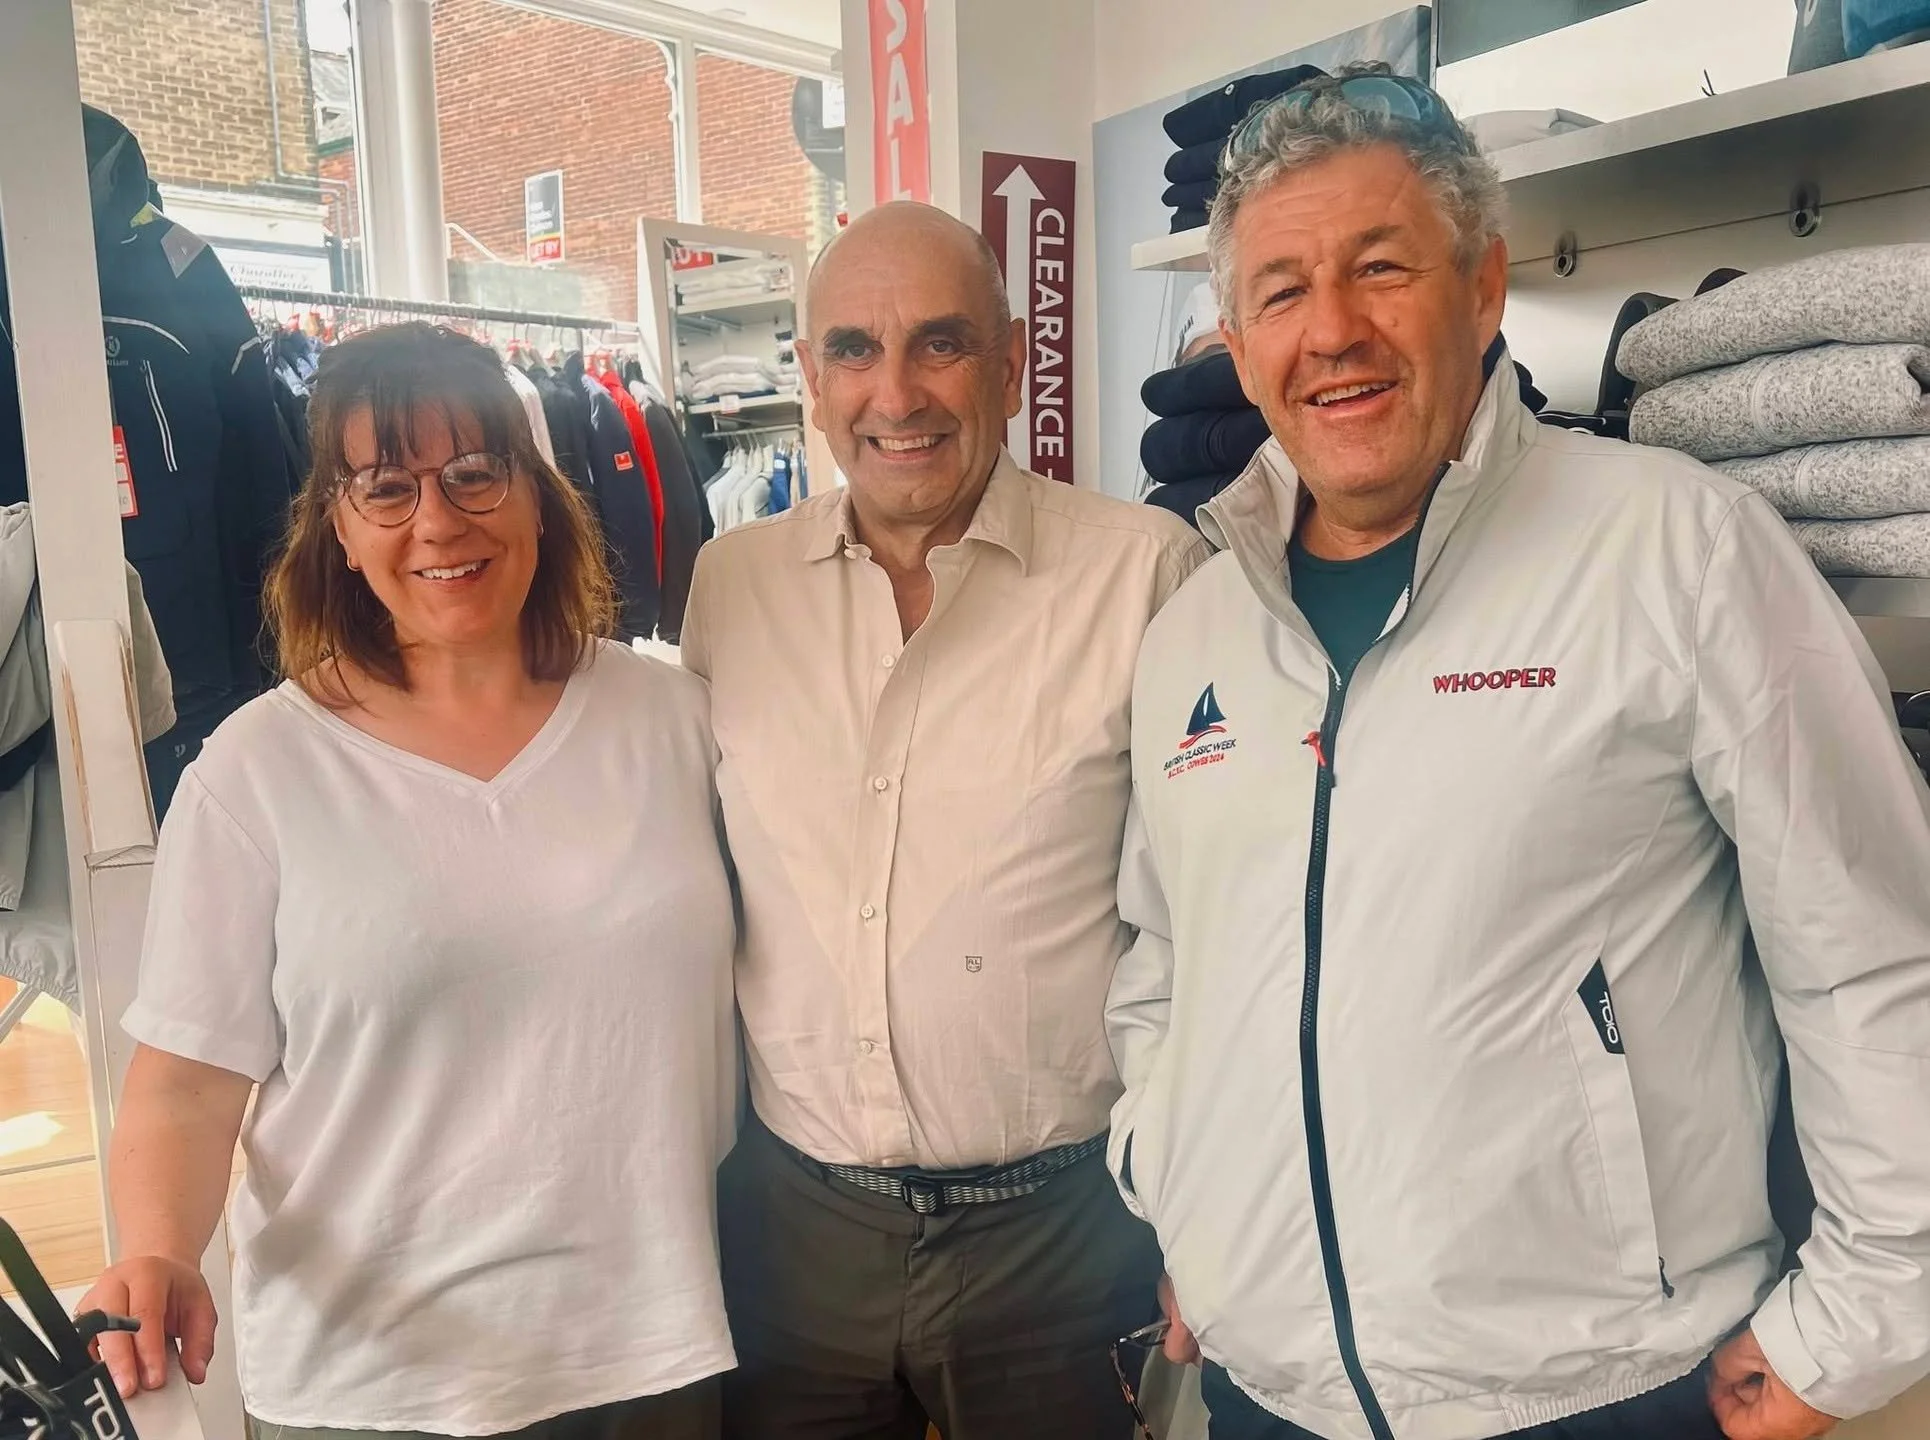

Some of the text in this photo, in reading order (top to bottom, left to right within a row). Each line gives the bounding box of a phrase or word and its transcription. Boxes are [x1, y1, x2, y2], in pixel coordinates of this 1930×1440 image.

[1035, 206, 1066, 458] CLEARANCE
[1432, 667, 1557, 694] WHOOPER
[1184, 743, 1212, 760] CLASSIC
[1213, 739, 1237, 752] WEEK
[83, 1377, 122, 1440] TO
